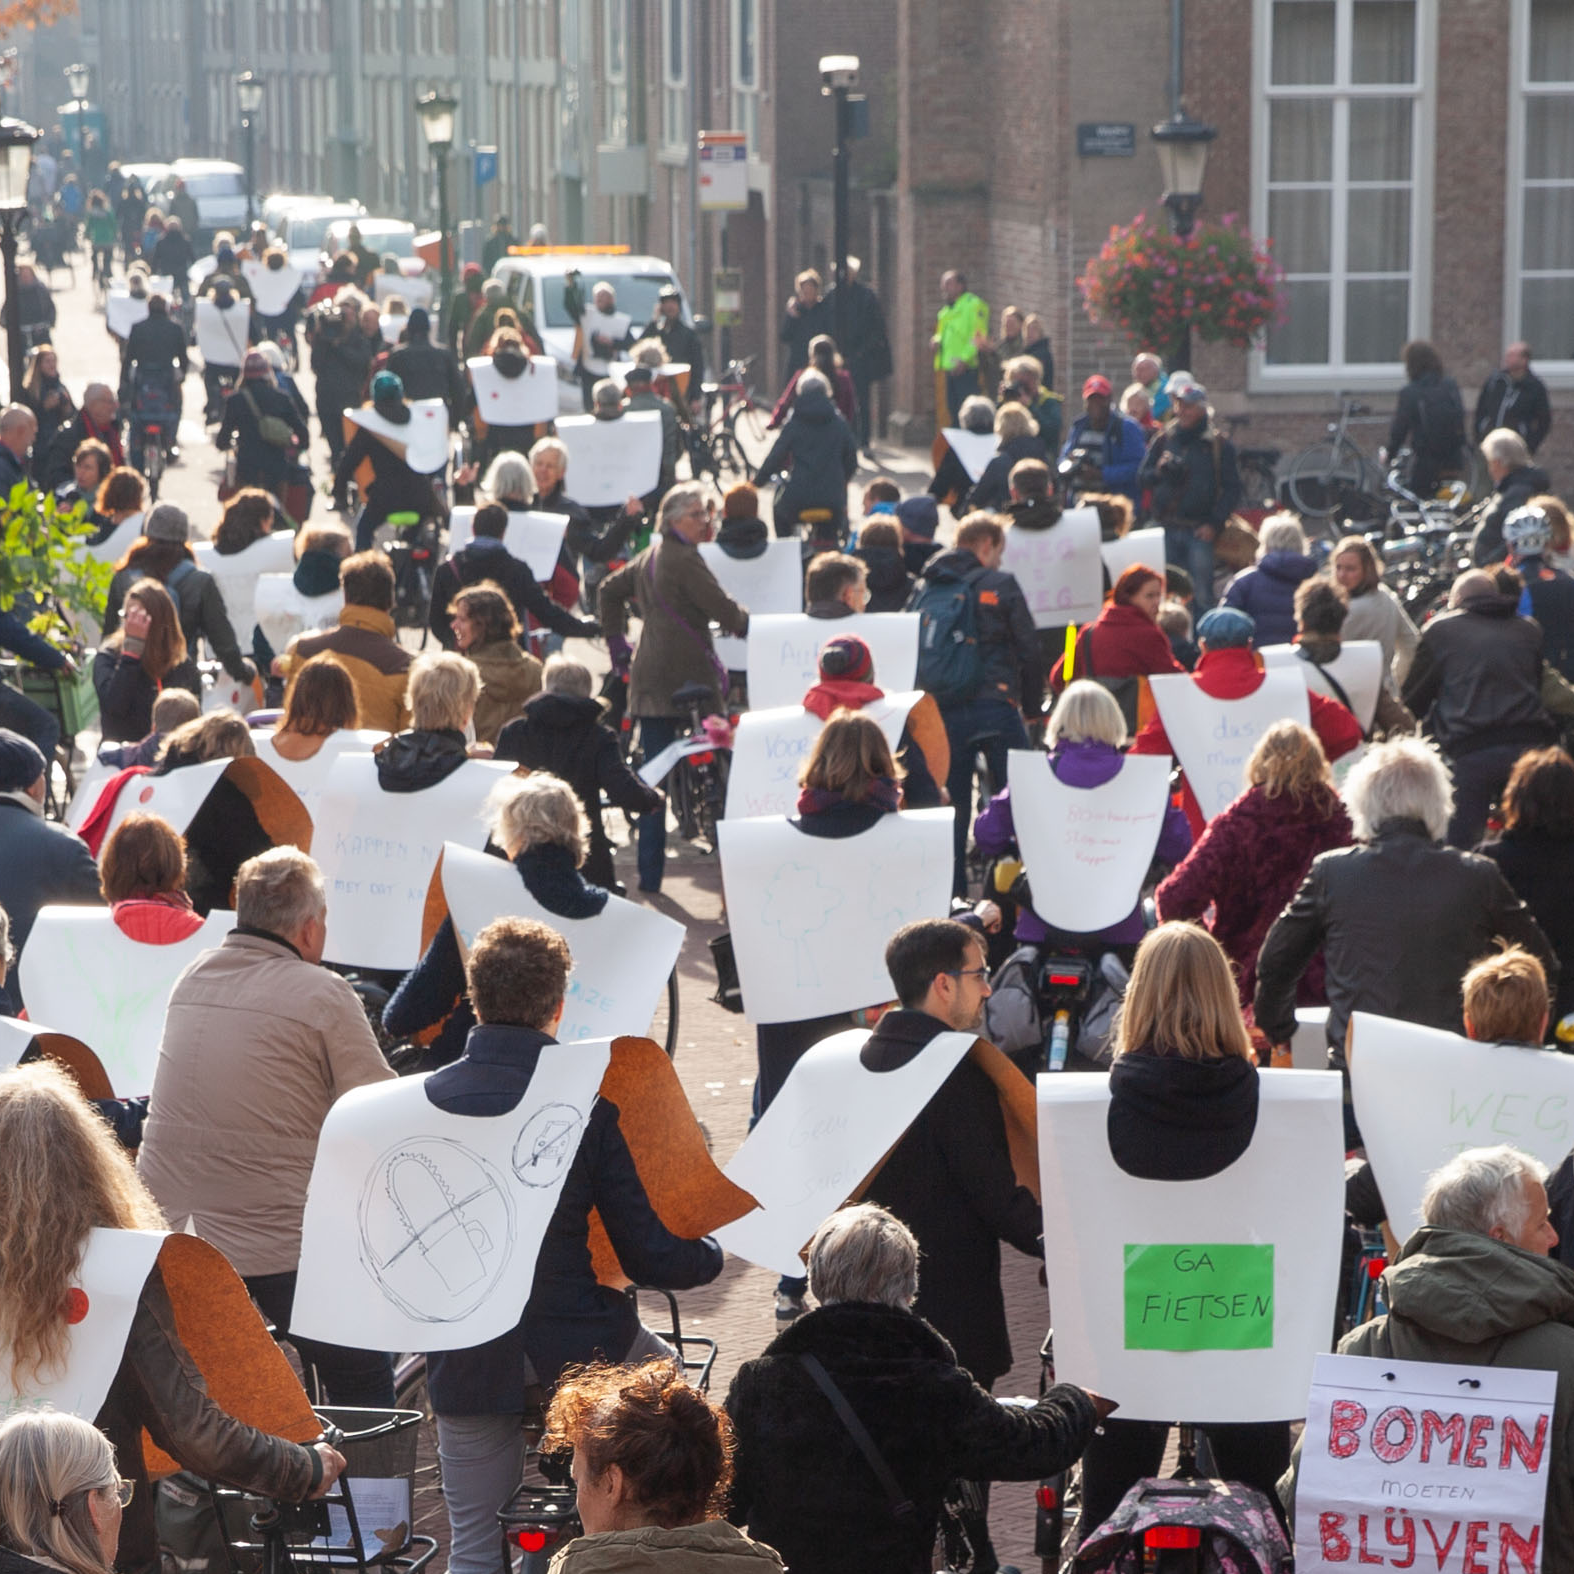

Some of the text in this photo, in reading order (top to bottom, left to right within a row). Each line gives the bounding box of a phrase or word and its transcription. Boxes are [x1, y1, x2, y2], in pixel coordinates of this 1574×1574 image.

[1023, 586, 1075, 610] EG
[1449, 1088, 1571, 1141] WEG
[1173, 1248, 1216, 1274] GA
[1327, 1399, 1549, 1475] BOMEN
